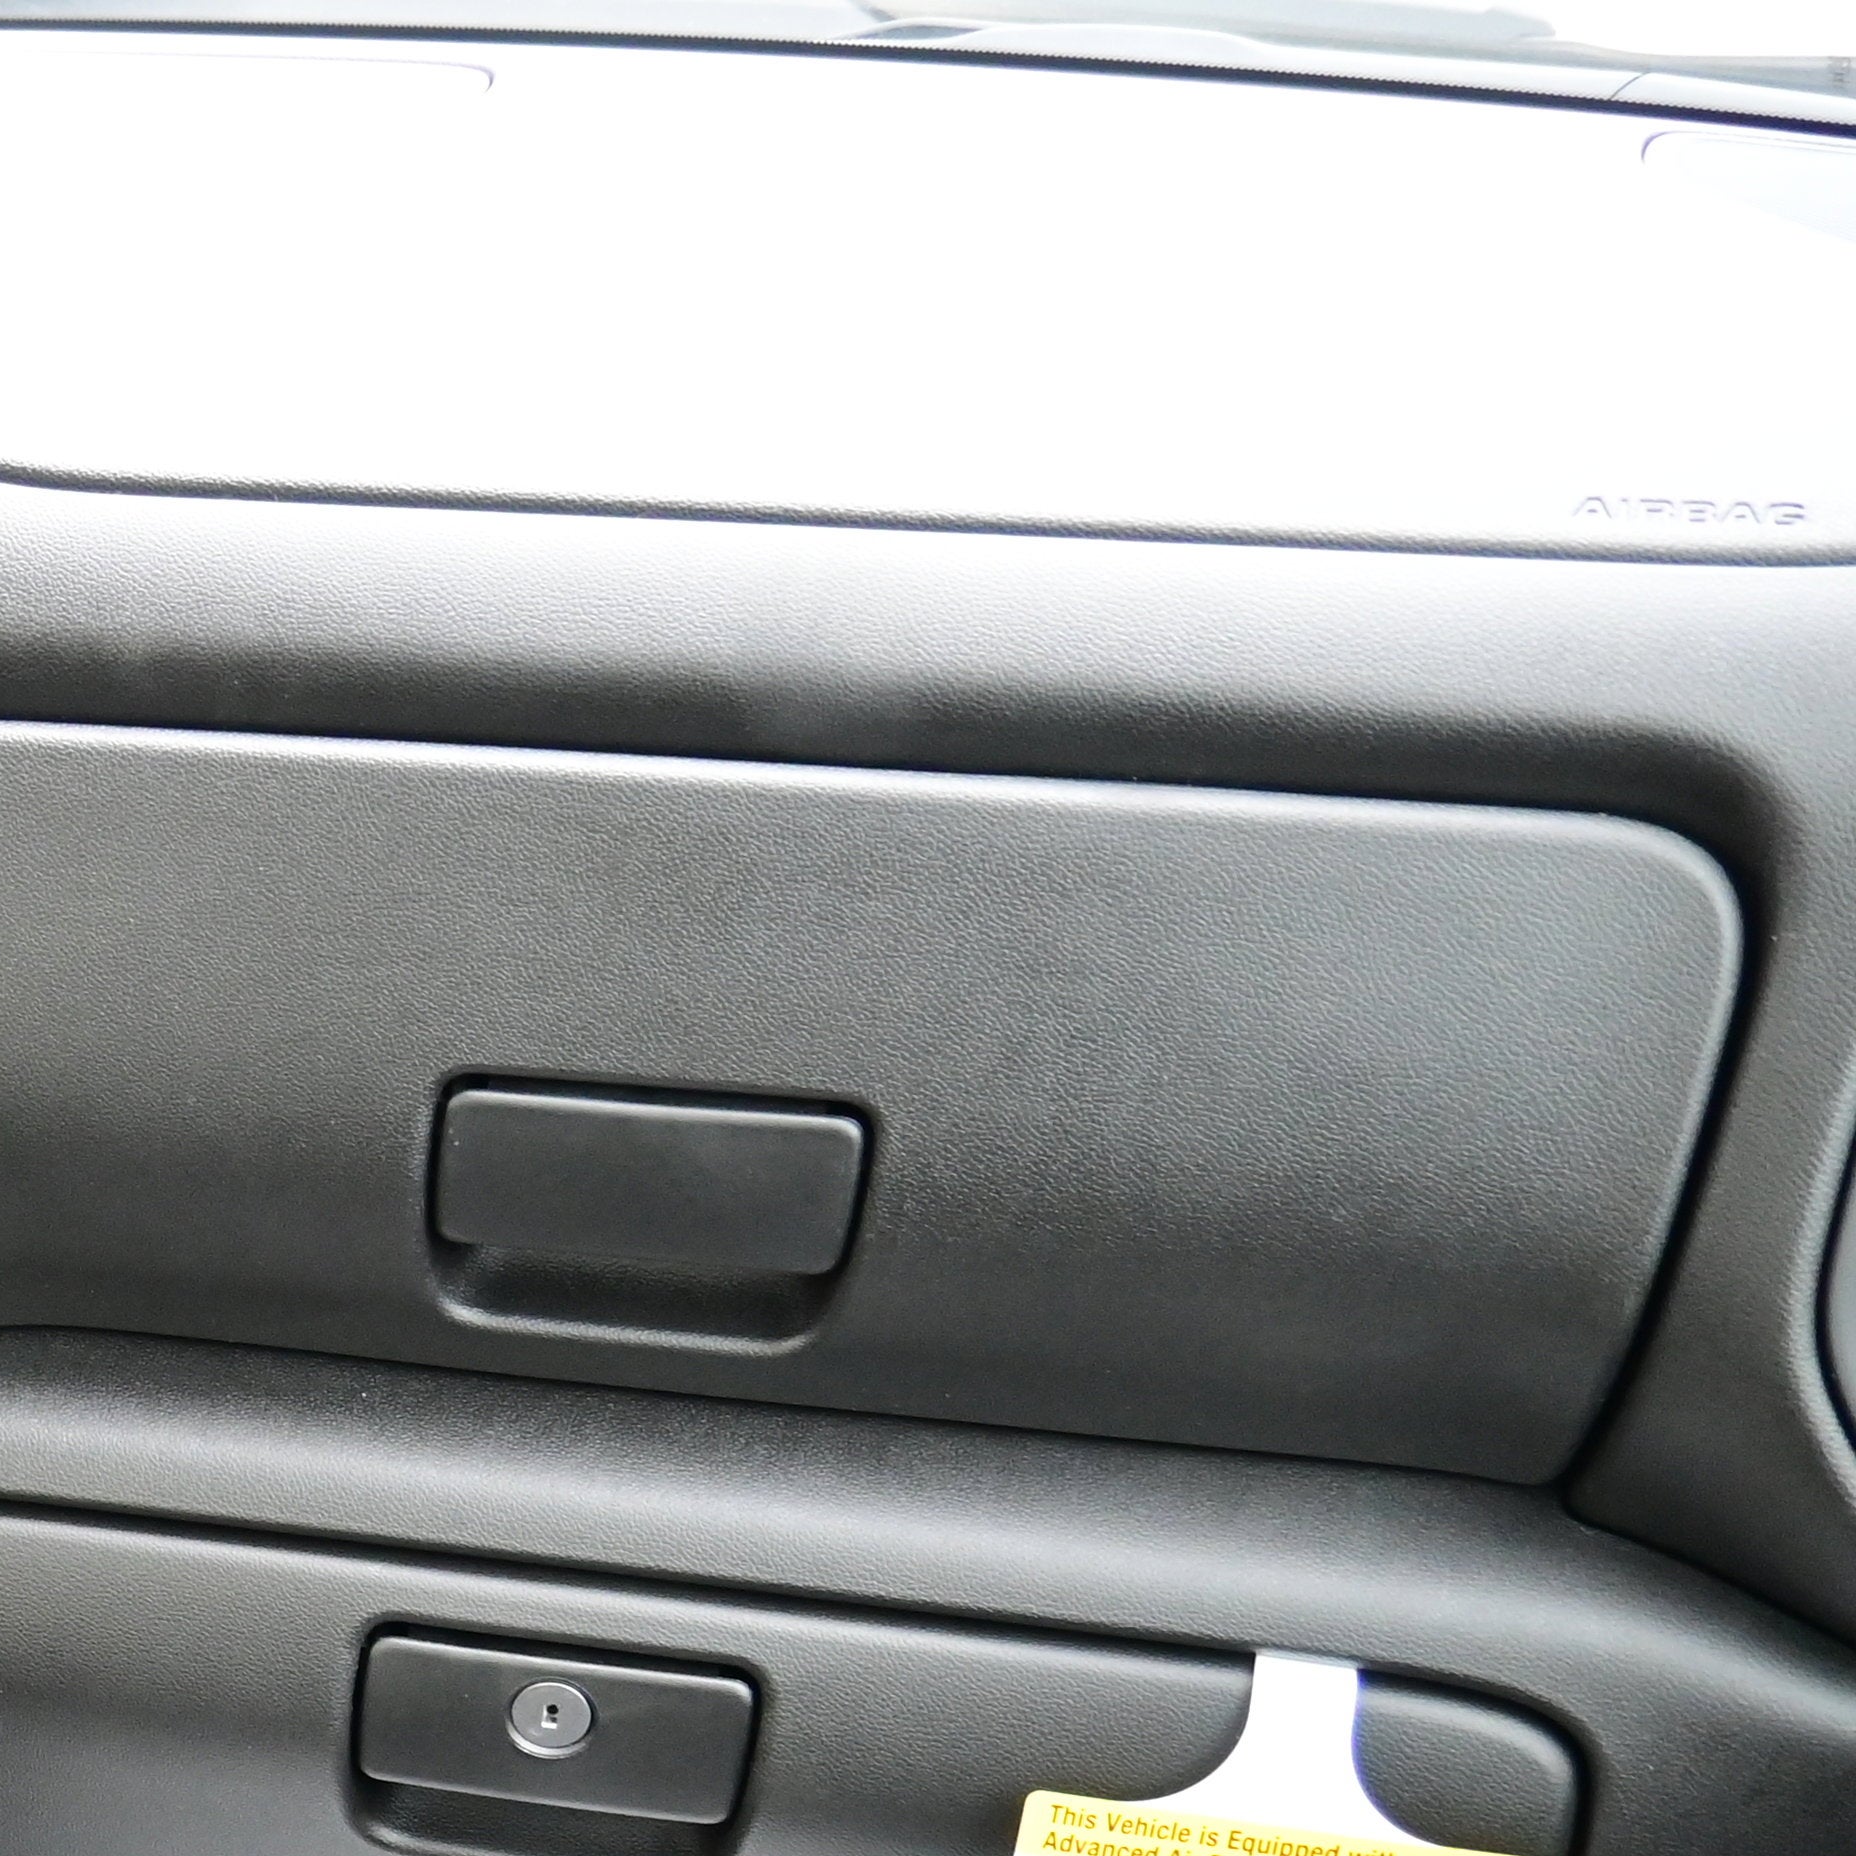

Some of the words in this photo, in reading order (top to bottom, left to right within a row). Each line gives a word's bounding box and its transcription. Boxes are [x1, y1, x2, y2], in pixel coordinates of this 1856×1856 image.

[1051, 1804, 1097, 1830] This
[1107, 1812, 1191, 1843] Vehicle
[1199, 1825, 1218, 1847] is
